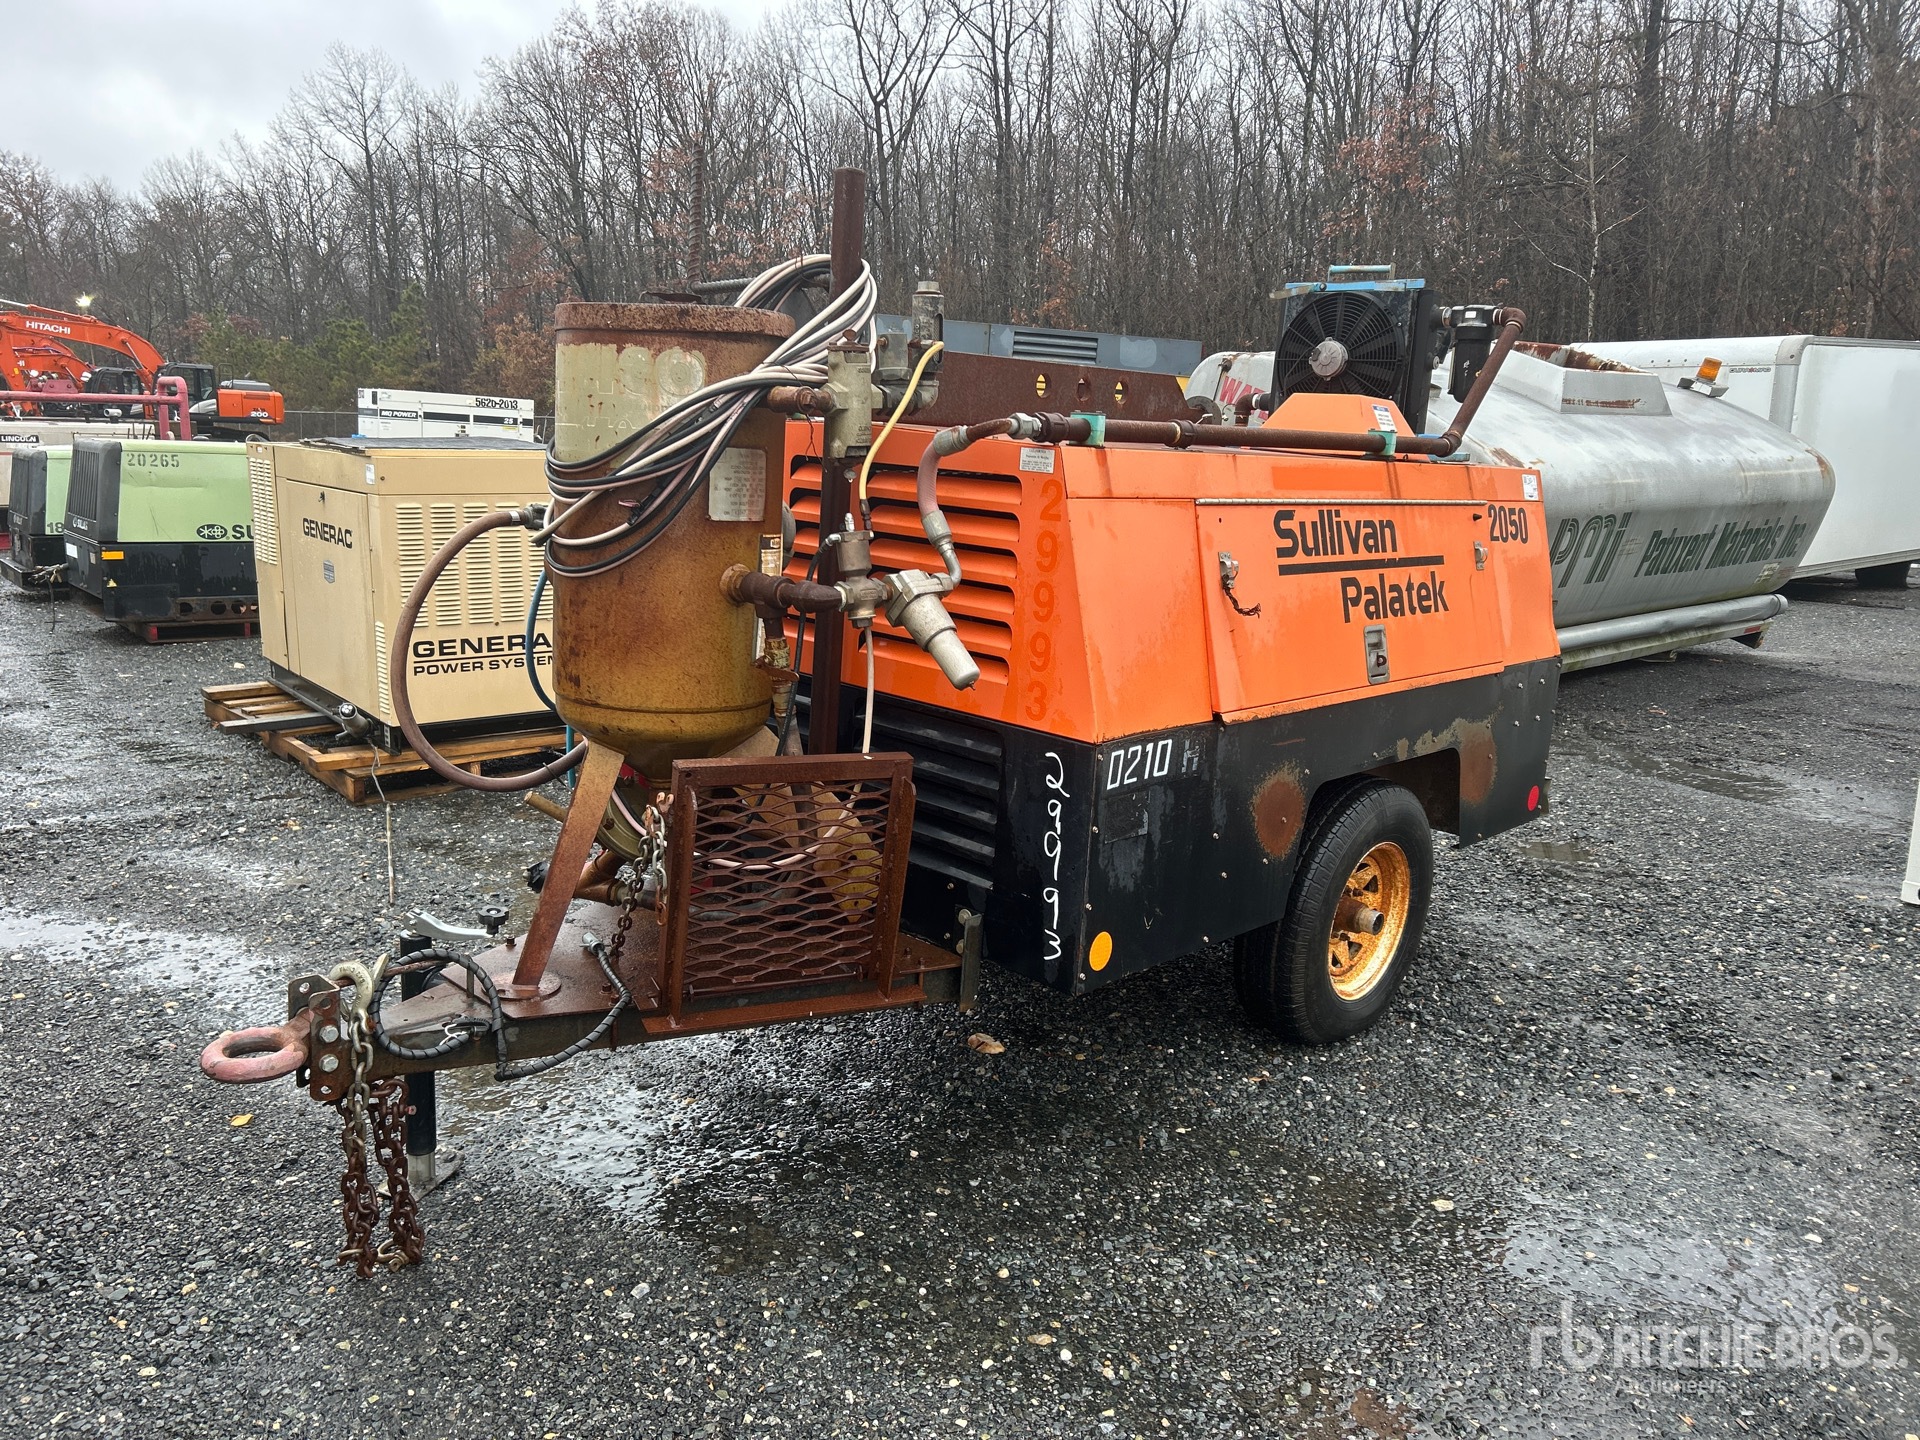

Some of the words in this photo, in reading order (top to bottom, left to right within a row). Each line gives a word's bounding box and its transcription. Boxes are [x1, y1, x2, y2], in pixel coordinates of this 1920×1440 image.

[26, 320, 71, 334] HITACHI
[475, 397, 518, 410] 5620-2013
[127, 453, 180, 468] 20265
[47, 522, 65, 533] 18
[302, 517, 353, 549] GENERAC
[1273, 509, 1398, 558] Sullivan
[1488, 504, 1529, 544] 2050
[1633, 528, 1716, 578] Patuxent
[1705, 516, 1786, 570] Materials
[1025, 479, 1063, 722] 29993
[1341, 571, 1449, 623] Palatek
[413, 661, 483, 676] POWER
[489, 656, 553, 670] SYSE
[1107, 739, 1172, 790] 0210
[1043, 752, 1071, 961] 29993
